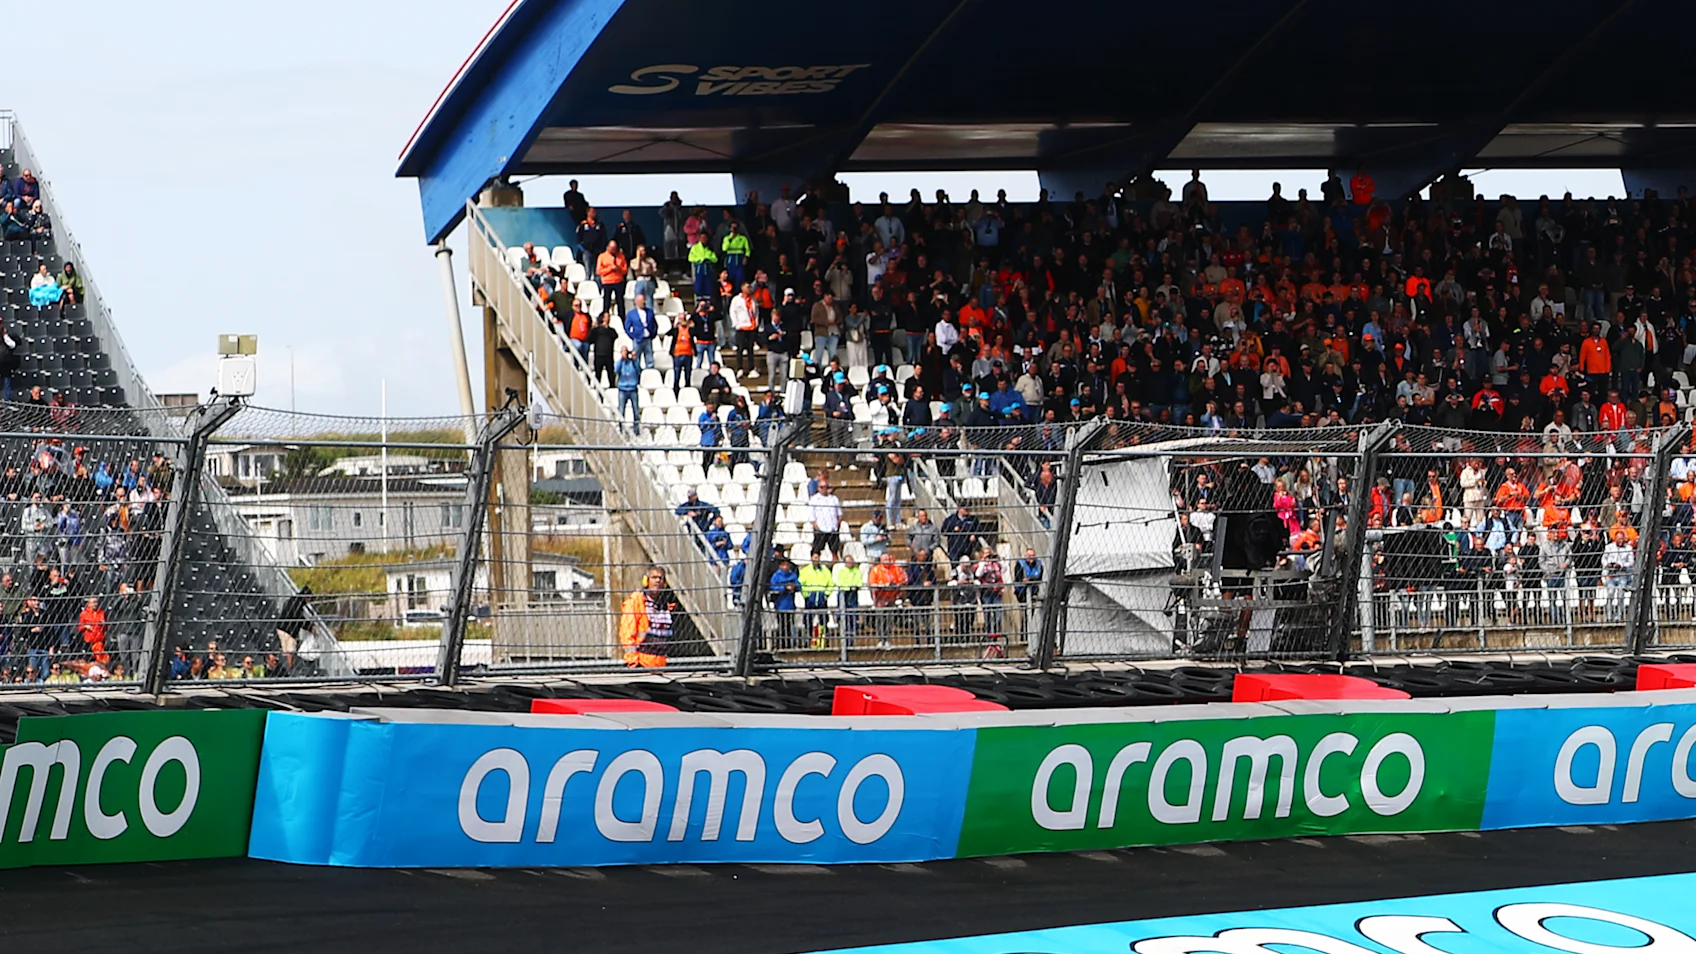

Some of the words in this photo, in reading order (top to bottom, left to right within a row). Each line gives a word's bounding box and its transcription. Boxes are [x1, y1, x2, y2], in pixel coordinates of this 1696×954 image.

[695, 79, 843, 96] VIBES
[697, 64, 871, 80] SPORT
[0, 735, 199, 844] mco
[457, 748, 905, 846] aramco
[1030, 731, 1425, 831] aramco
